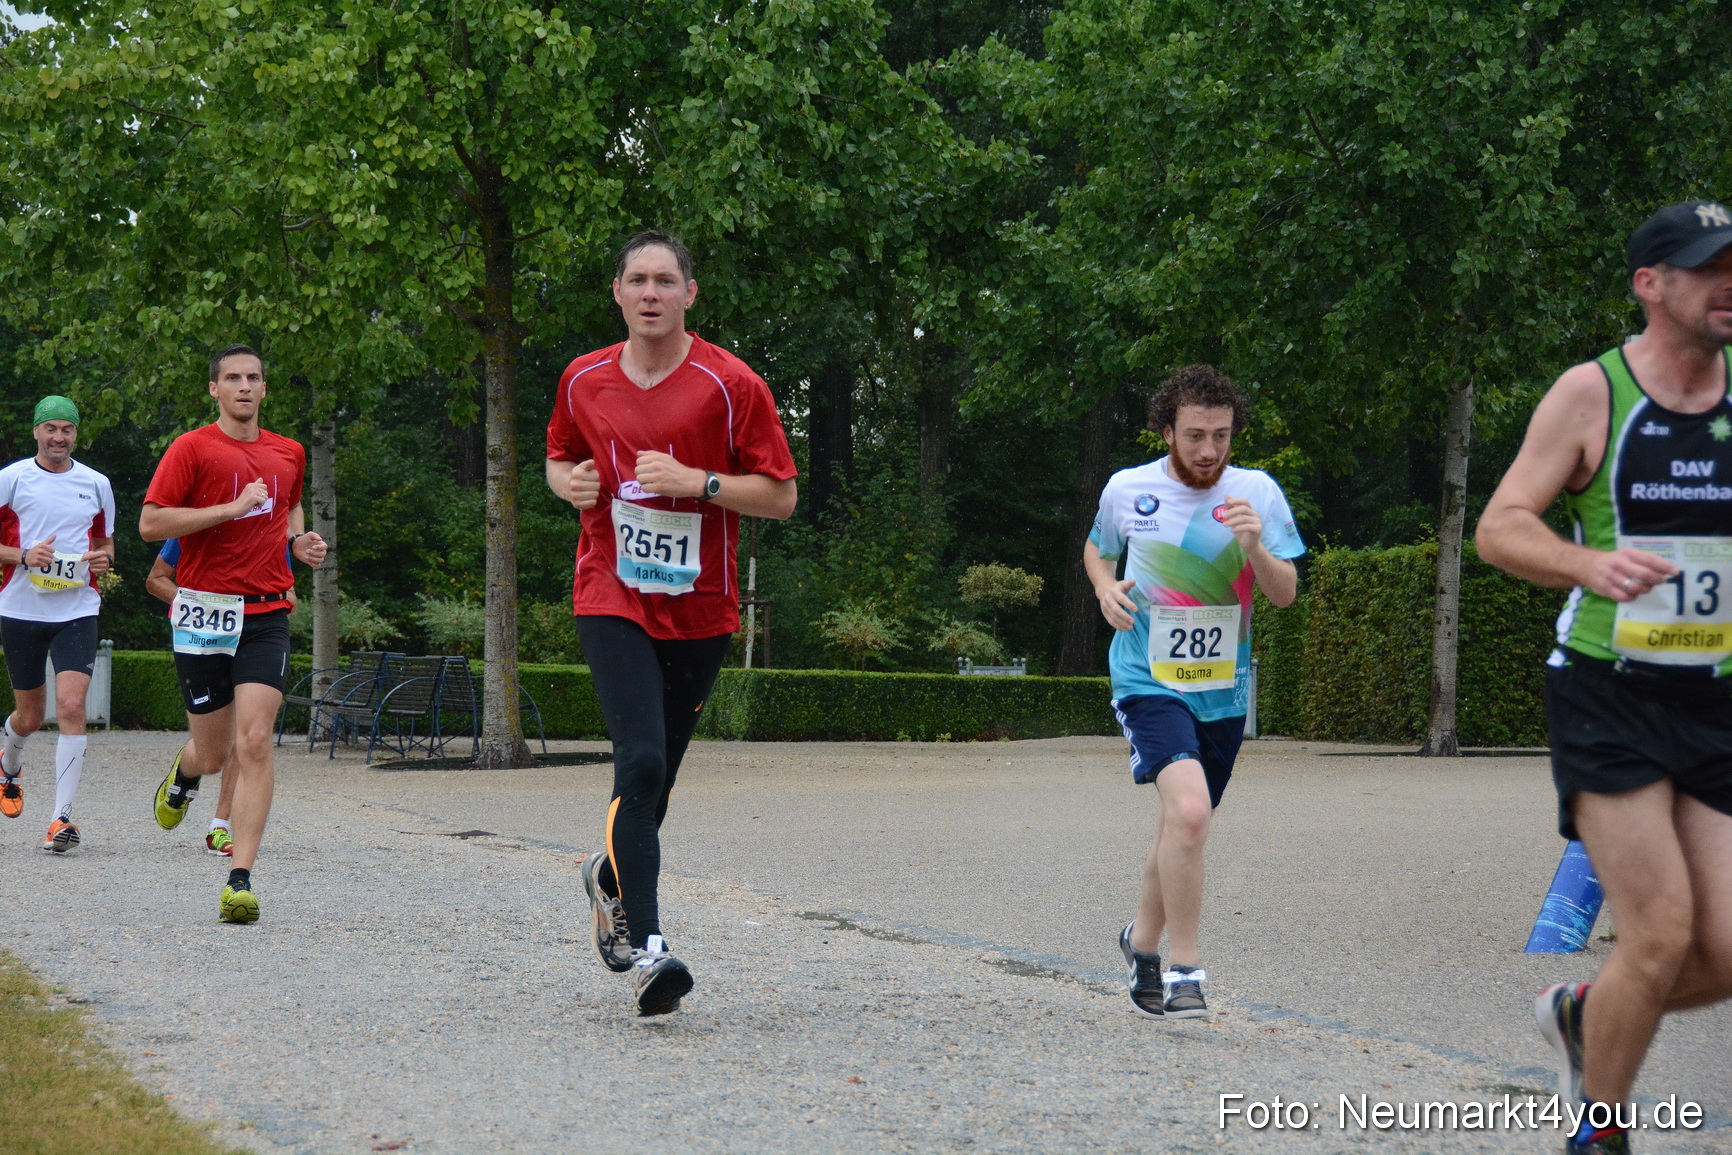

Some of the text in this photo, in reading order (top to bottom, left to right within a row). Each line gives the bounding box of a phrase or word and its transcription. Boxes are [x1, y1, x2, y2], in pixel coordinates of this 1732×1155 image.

[1671, 460, 1714, 477] DAV
[1631, 483, 1732, 500] Röthenba
[650, 513, 693, 527] BOCK
[620, 523, 689, 566] 2551
[635, 566, 674, 583] Markus
[202, 594, 237, 604] BOCK
[1666, 570, 1720, 616] 13
[178, 603, 236, 632] 2346
[1192, 609, 1233, 620] BOCK
[189, 634, 218, 647] Jürgen
[1169, 627, 1222, 658] 282
[1647, 629, 1724, 648] Christian
[1176, 667, 1212, 680] Osama
